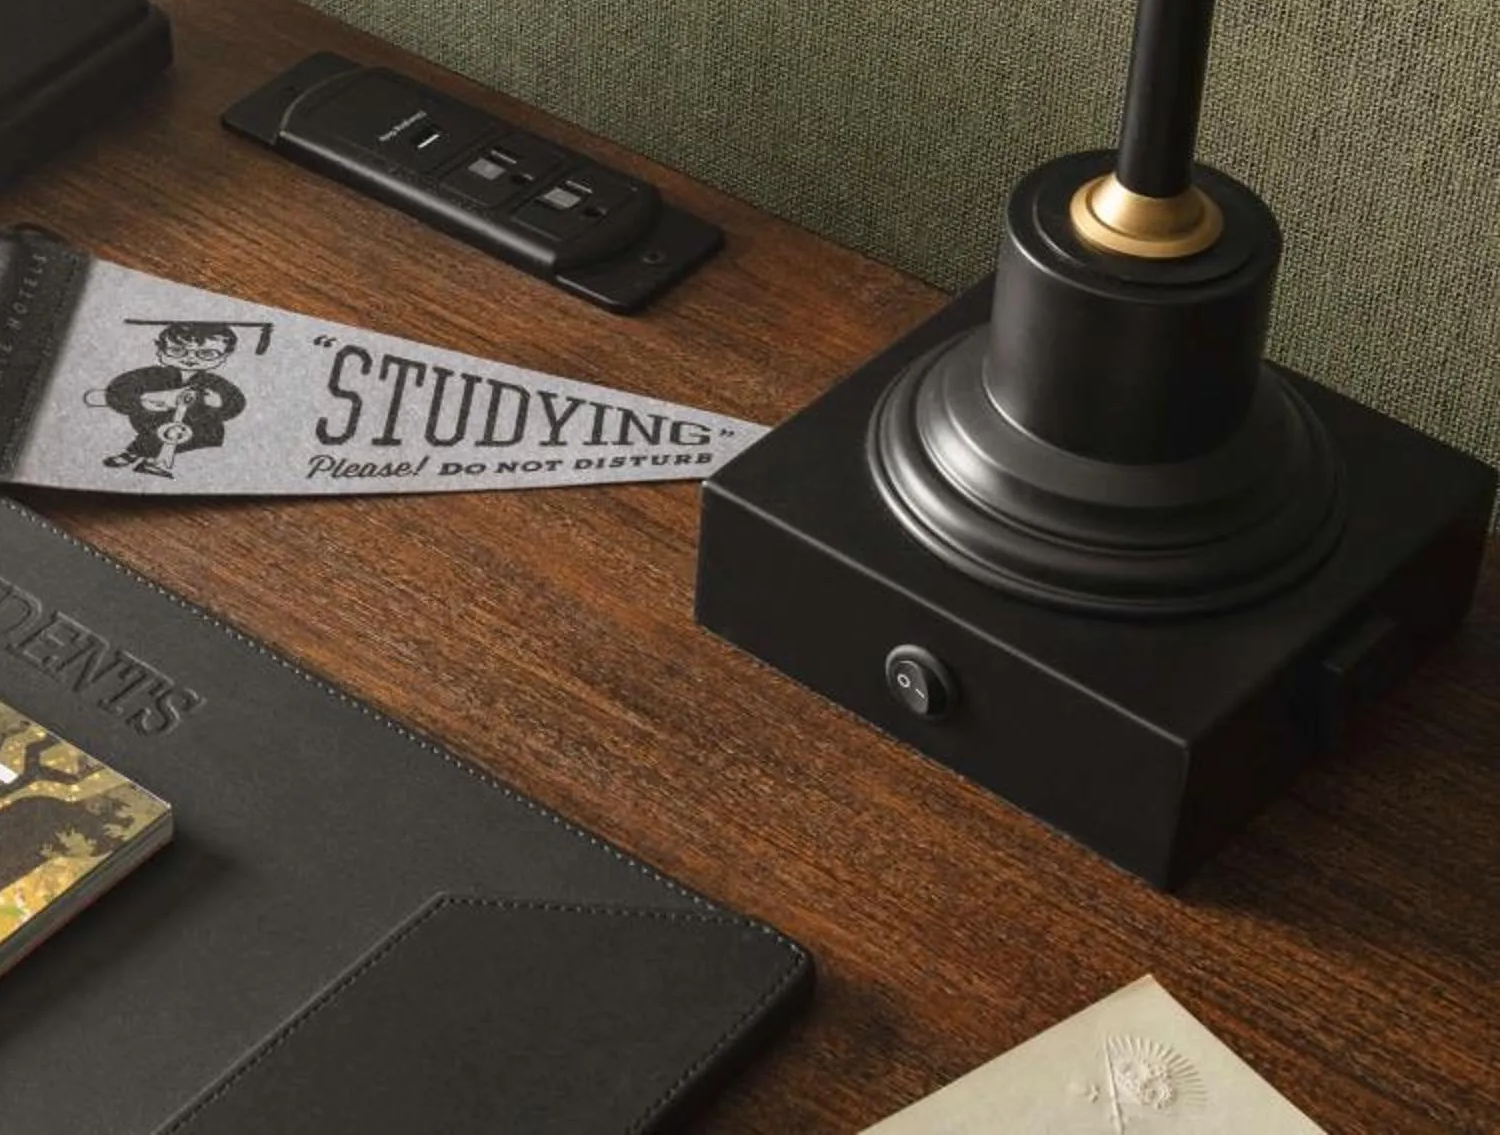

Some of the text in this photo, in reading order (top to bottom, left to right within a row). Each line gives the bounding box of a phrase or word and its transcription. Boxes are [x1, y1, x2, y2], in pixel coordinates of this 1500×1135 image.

[306, 452, 714, 479] Please! DO NOT DISTURB
